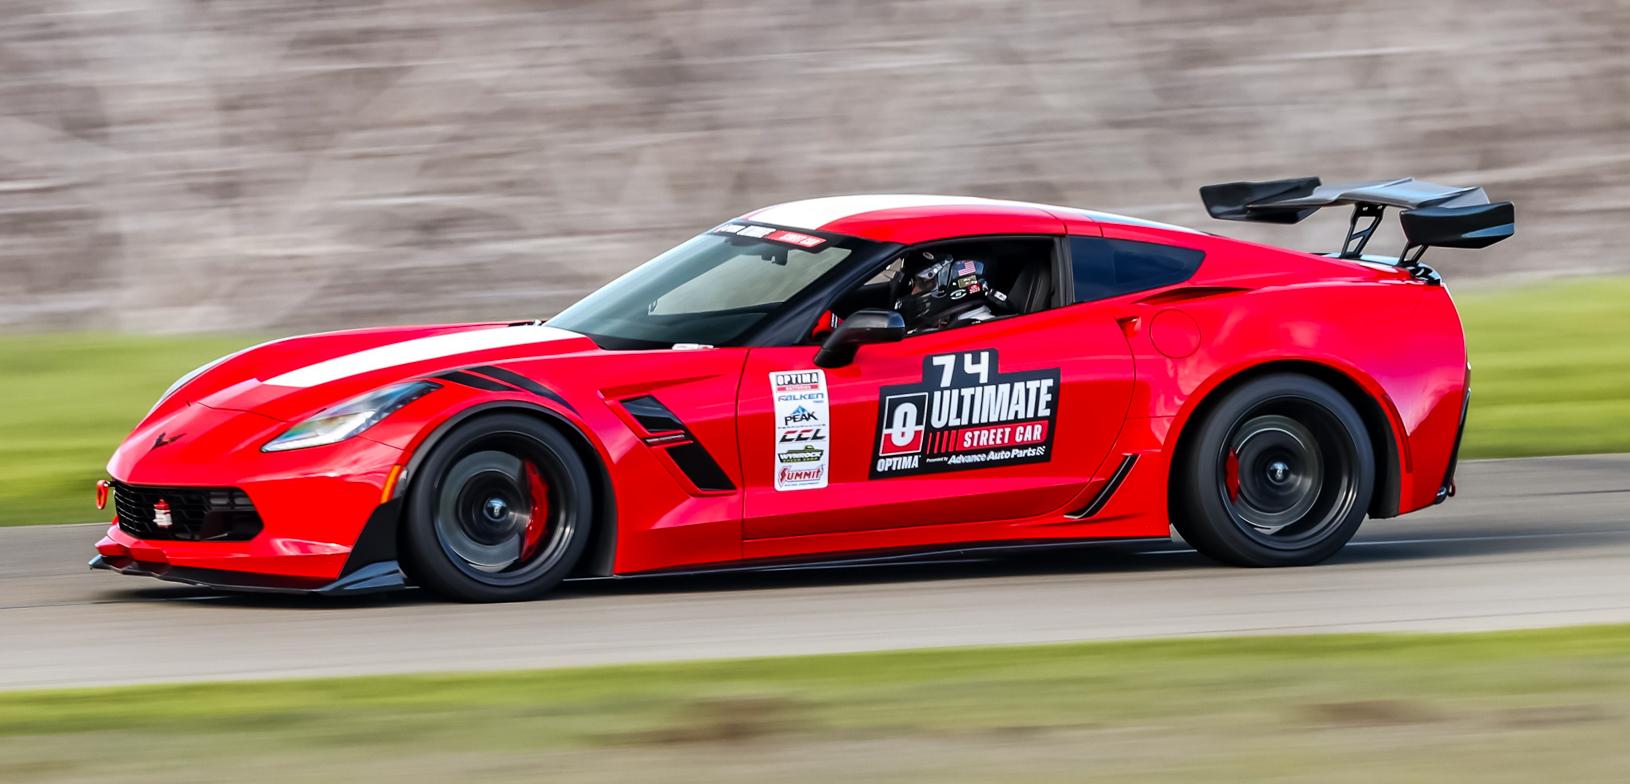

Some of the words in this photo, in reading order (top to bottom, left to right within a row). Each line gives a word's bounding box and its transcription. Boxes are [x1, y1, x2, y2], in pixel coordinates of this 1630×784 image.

[933, 351, 989, 387] 74
[777, 373, 818, 385] OPTIMA
[778, 393, 824, 401] FALKEN
[930, 379, 1053, 429] ULTIMATE
[784, 411, 818, 426] PEAK
[779, 428, 826, 442] CCL
[963, 428, 1012, 448] STREET
[1015, 424, 1042, 443] CAR
[876, 455, 919, 472] OPTIMA
[947, 454, 987, 465] Advance
[987, 450, 1010, 461] Auto
[1011, 447, 1037, 459] Parts
